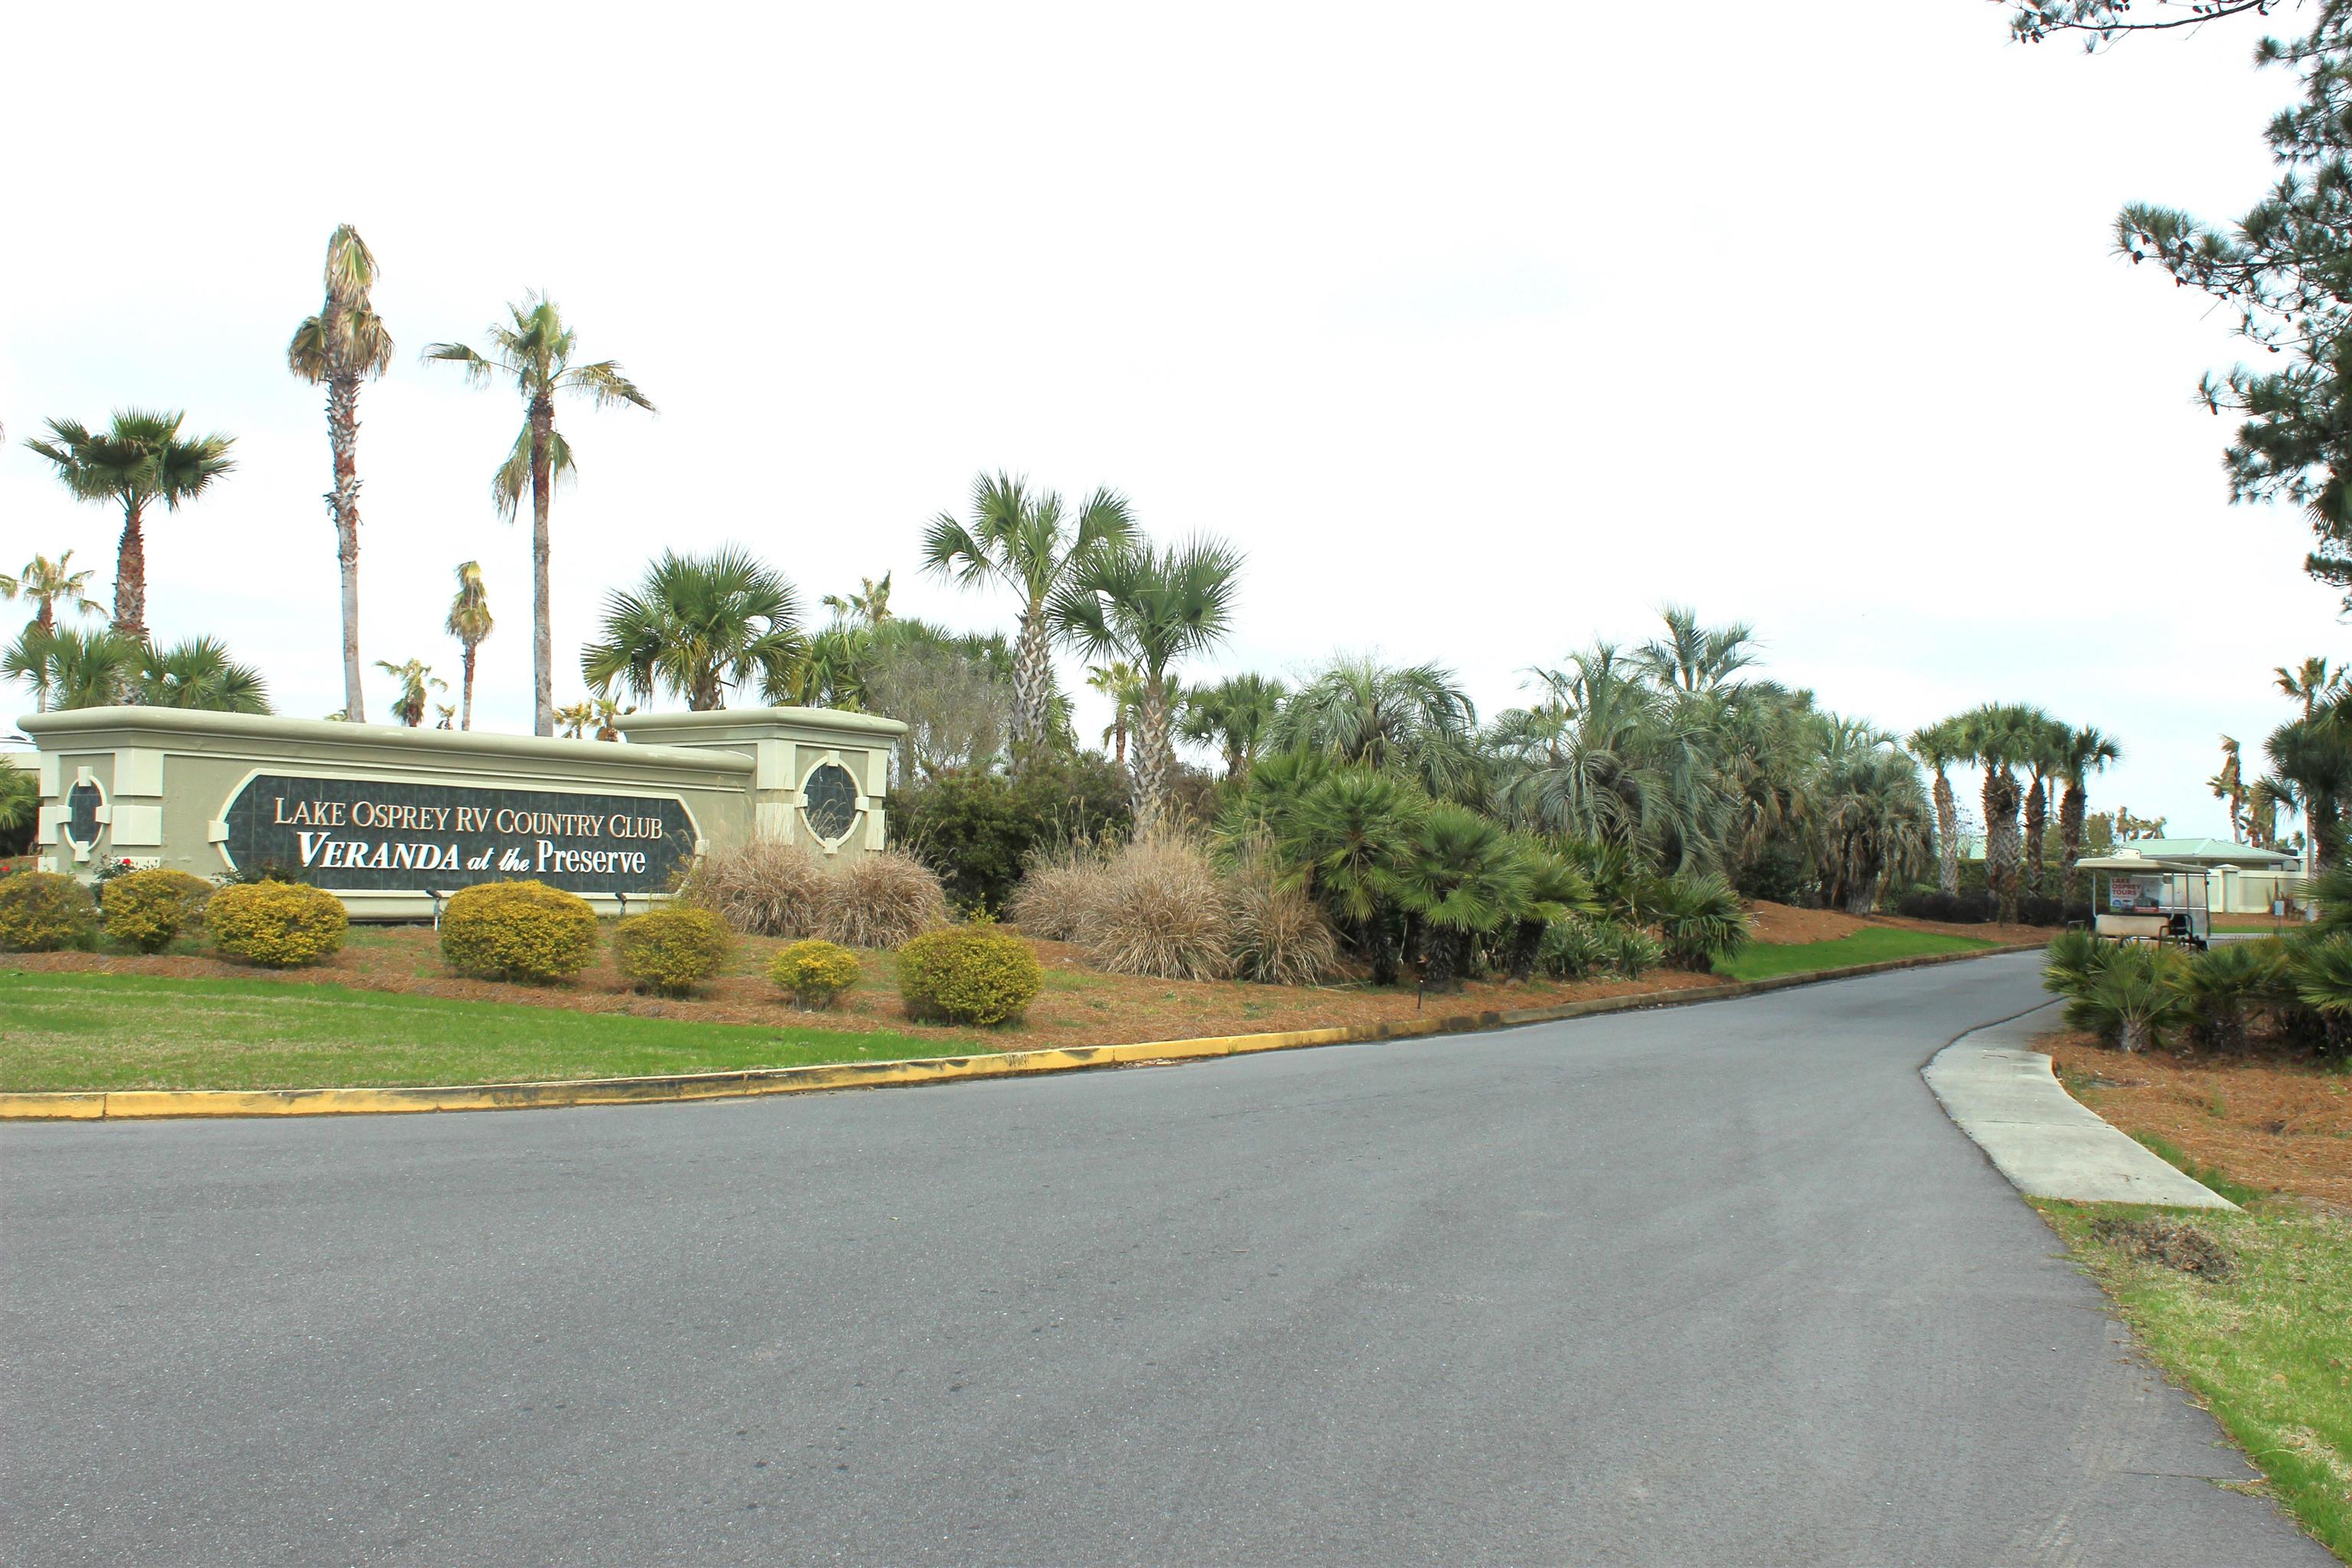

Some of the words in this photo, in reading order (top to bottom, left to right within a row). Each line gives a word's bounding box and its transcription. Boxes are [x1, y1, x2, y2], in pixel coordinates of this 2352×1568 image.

[274, 797, 346, 826] LAKE
[352, 801, 451, 831] OSPREY
[456, 806, 492, 832] RV
[496, 808, 604, 837] COUNTRY
[609, 814, 663, 840] CLUB
[296, 831, 459, 871] VERANDA
[466, 847, 495, 871] at
[498, 847, 530, 872] the
[536, 839, 645, 874] Preserve
